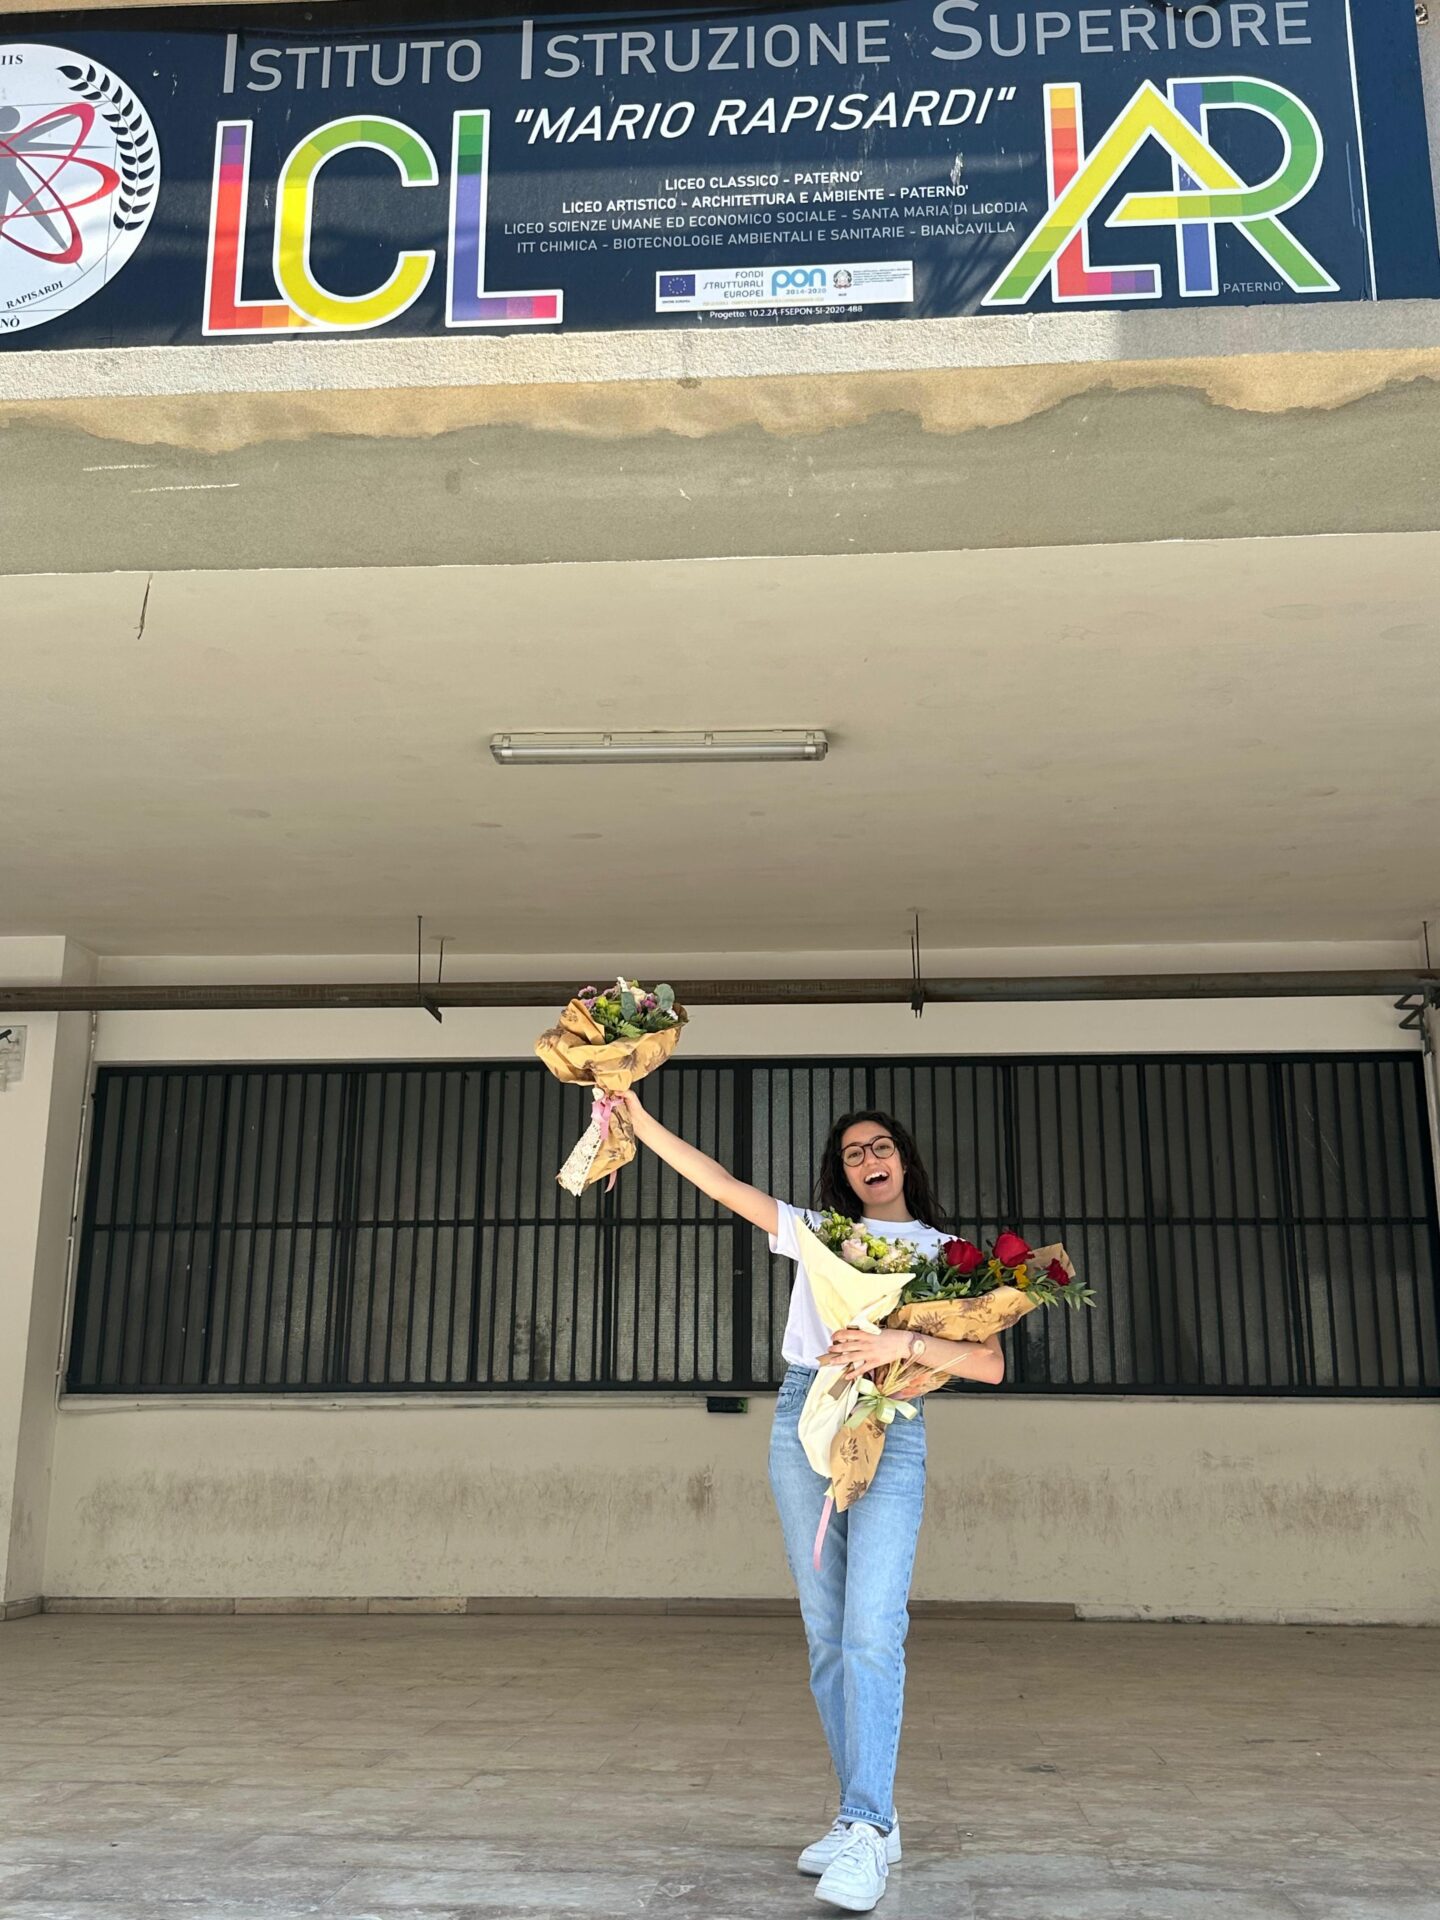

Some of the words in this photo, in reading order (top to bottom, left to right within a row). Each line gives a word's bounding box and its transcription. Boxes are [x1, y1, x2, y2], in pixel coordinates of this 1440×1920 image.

[222, 33, 482, 94] ISTITUTO
[520, 19, 892, 81] ISTRUZIONE
[931, 0, 1312, 61] SUPERIORE
[665, 178, 706, 191] LICEO
[709, 174, 778, 189] CLASSICO
[794, 171, 863, 185] PATERNO'
[562, 201, 603, 214] LICEO
[606, 197, 677, 212] ARTISTICO
[691, 191, 796, 209] ARCHITETTURA
[800, 192, 808, 203] E
[812, 188, 885, 203] AMBIENTE
[900, 185, 969, 199] PATERNO'
[202, 109, 563, 336] LCL
[504, 222, 544, 235] LICEO
[549, 220, 607, 233] SCIENZE
[611, 217, 662, 231] UMANE
[666, 216, 685, 228] ED
[689, 213, 772, 227] ECONOMICO
[776, 210, 836, 224] SOCIALE
[852, 207, 900, 220] SANTA
[904, 204, 949, 218] MARIA
[954, 204, 967, 215] DI
[972, 201, 1028, 214] LICODIA
[517, 241, 536, 253] ITT
[539, 239, 598, 253] CHIMICA
[613, 234, 723, 250] BIOTECNOLOGIE
[727, 230, 813, 245] AMBIENTALI
[818, 229, 826, 241] E
[830, 226, 904, 240] SANITARIE
[921, 221, 1016, 237] BIANCAVILLA
[6, 280, 63, 309] RAPISARDI
[723, 290, 764, 298] EUROPEI
[771, 268, 826, 296] pon
[786, 287, 827, 295] 2014-2020
[1223, 281, 1284, 293] PATERNO'
[709, 310, 747, 320] Progetto:
